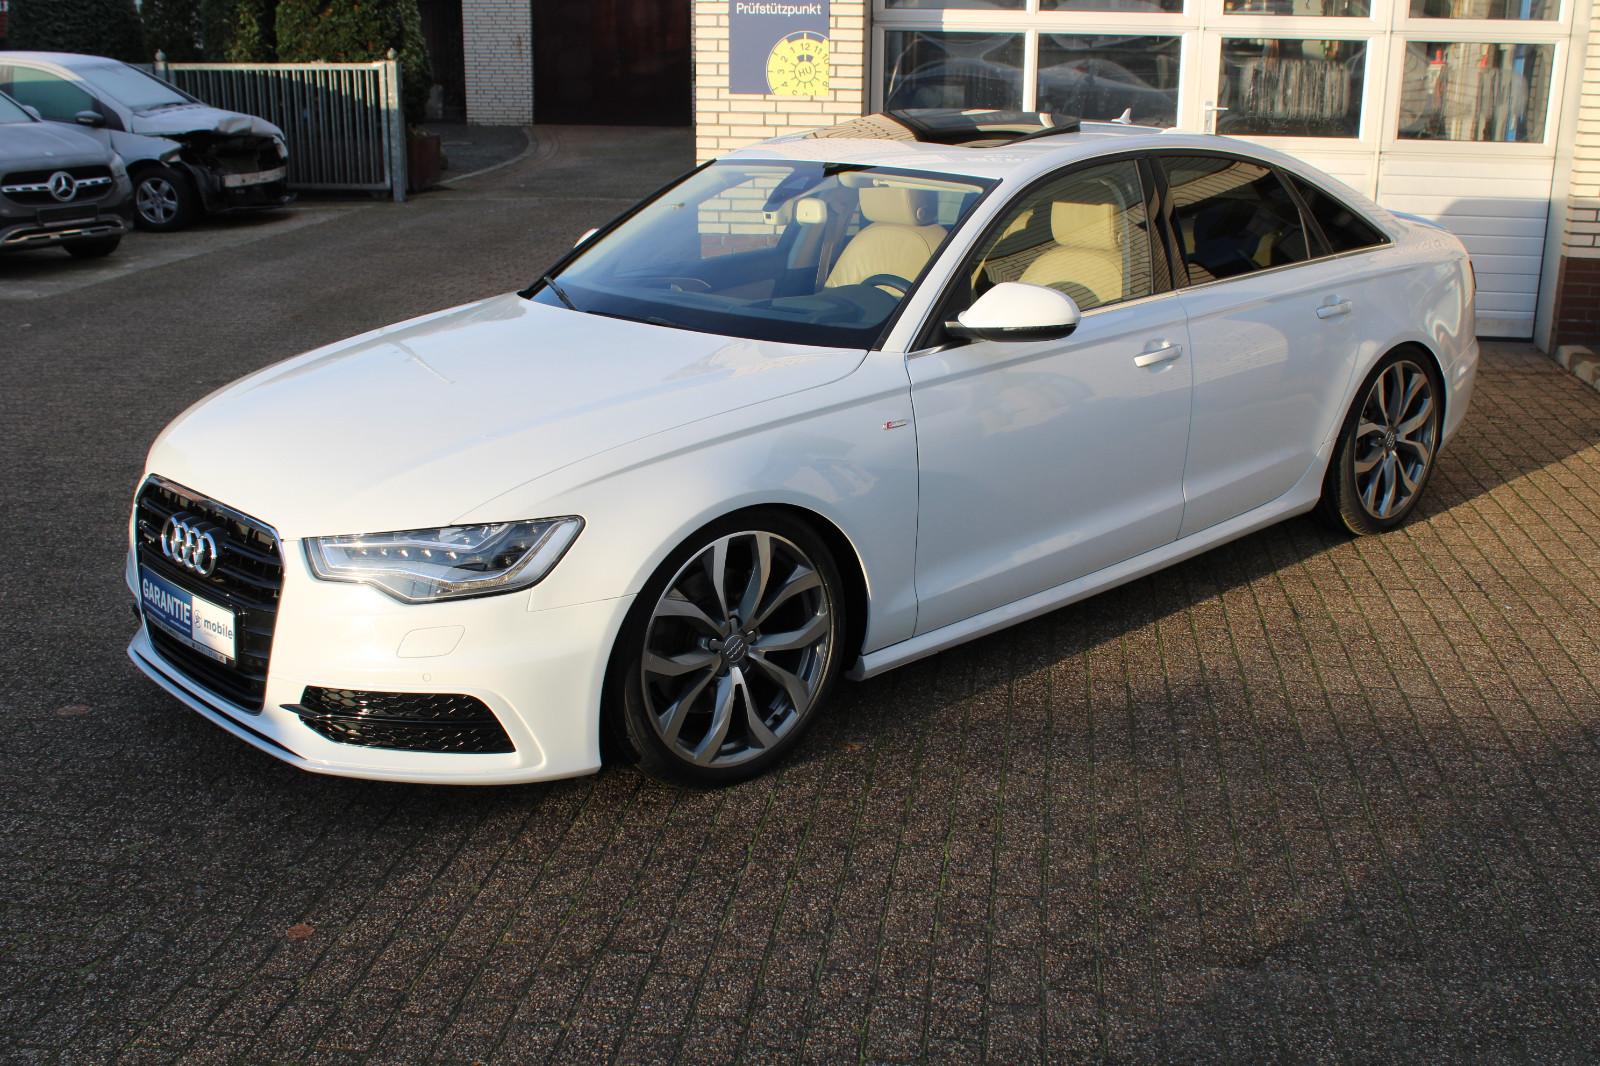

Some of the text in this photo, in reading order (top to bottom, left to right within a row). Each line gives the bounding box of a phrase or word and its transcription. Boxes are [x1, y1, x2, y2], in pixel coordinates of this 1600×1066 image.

[736, 3, 821, 17] Prüfstützpunkt
[800, 43, 811, 51] 12
[780, 55, 788, 63] 2
[798, 66, 812, 77] HU
[142, 578, 191, 626] GARANTIE
[203, 618, 233, 640] mobile
